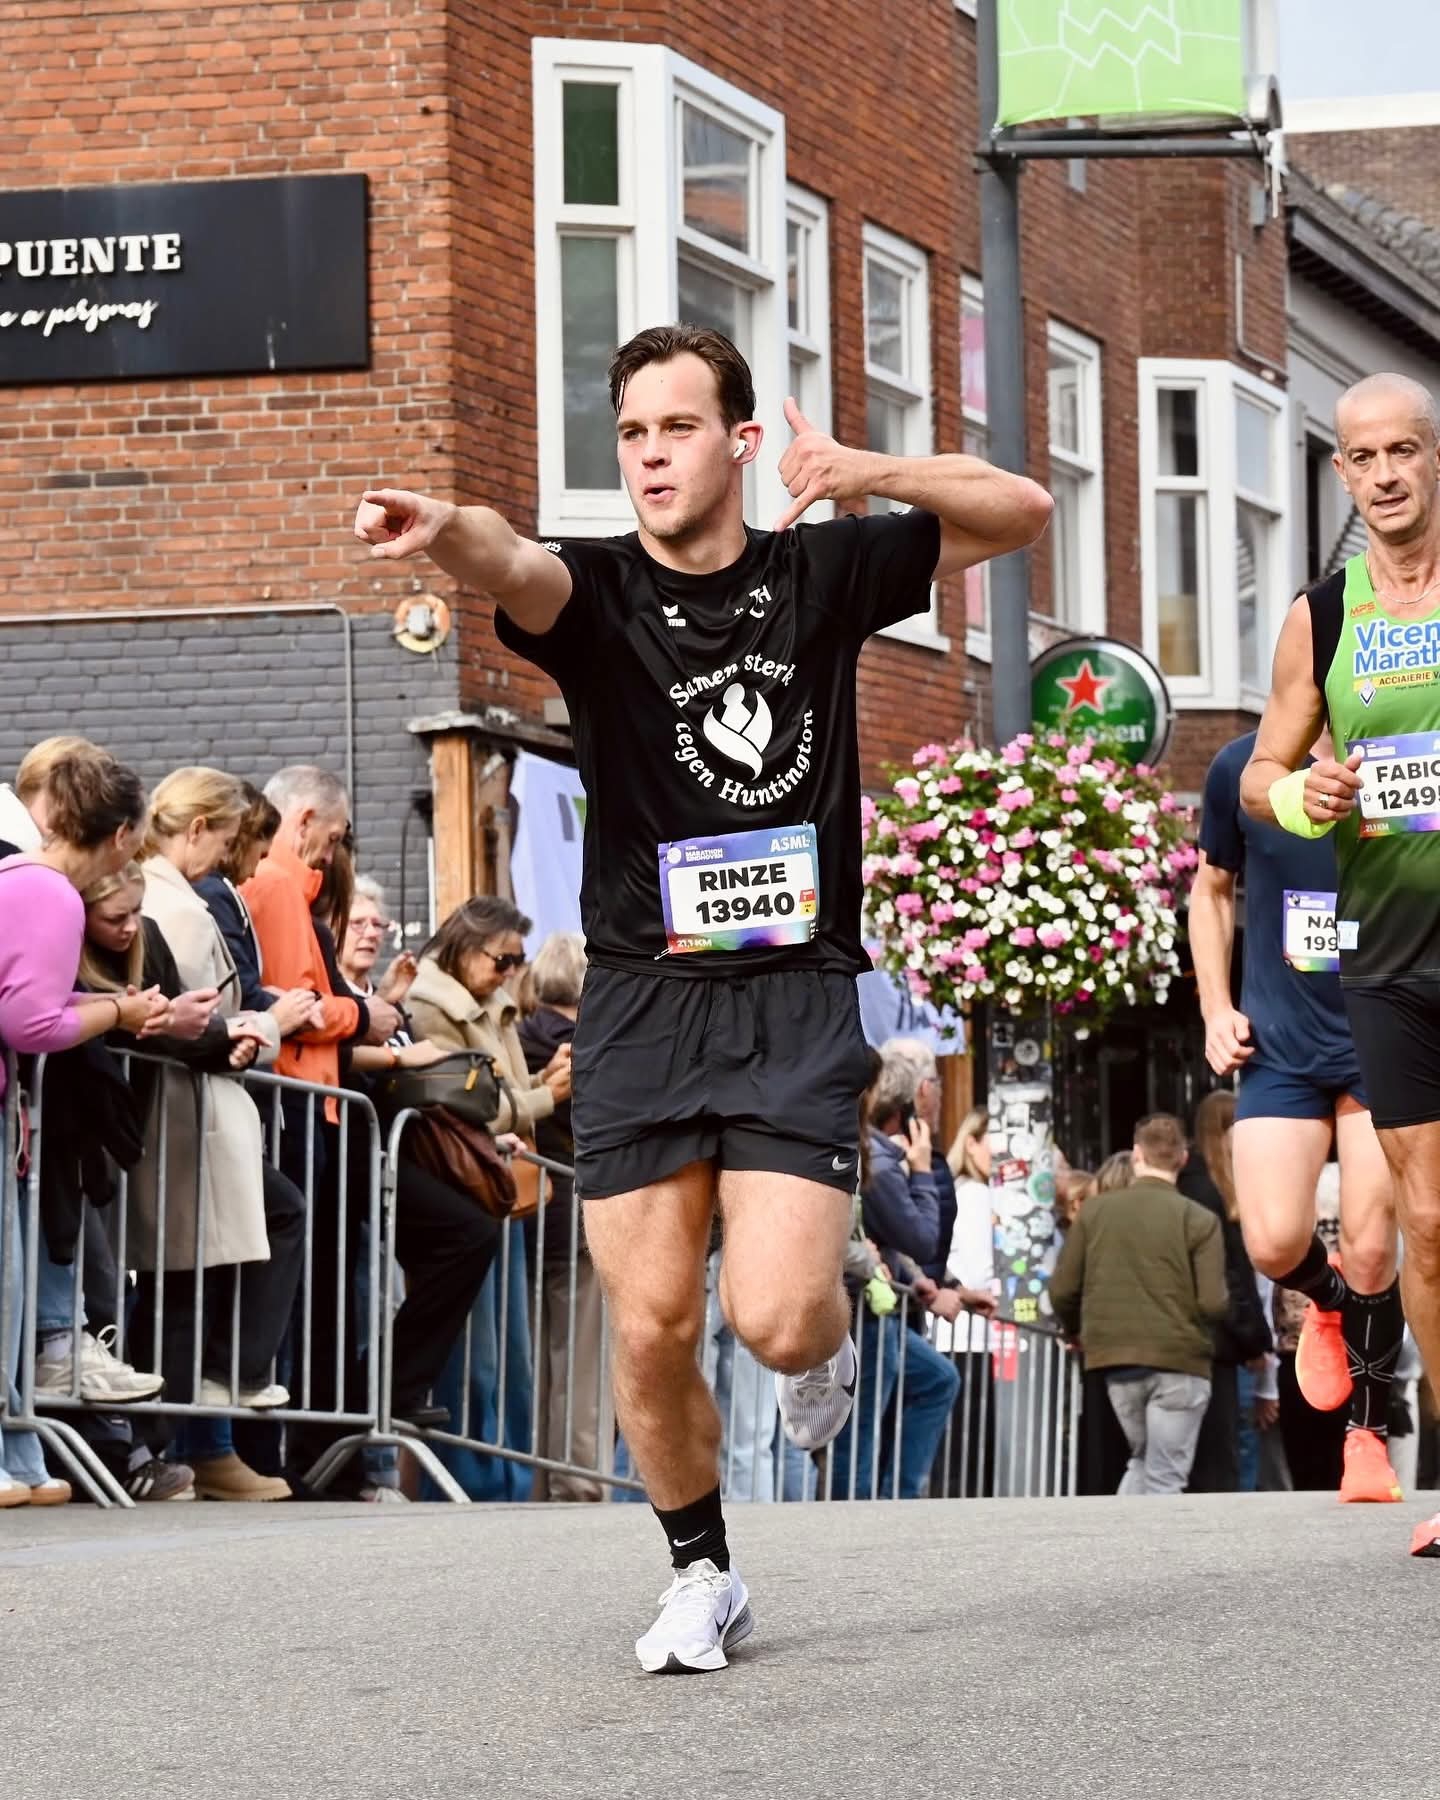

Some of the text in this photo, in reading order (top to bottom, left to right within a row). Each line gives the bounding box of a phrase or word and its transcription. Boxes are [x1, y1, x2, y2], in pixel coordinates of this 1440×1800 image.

[669, 653, 796, 708] Samen sterk
[1379, 671, 1431, 685] ACCIAIERIE
[718, 709, 813, 806] Huntington
[1378, 784, 1440, 810] 1249
[771, 834, 810, 852] ASML
[699, 862, 787, 892] RINZE
[696, 892, 795, 924] 13940
